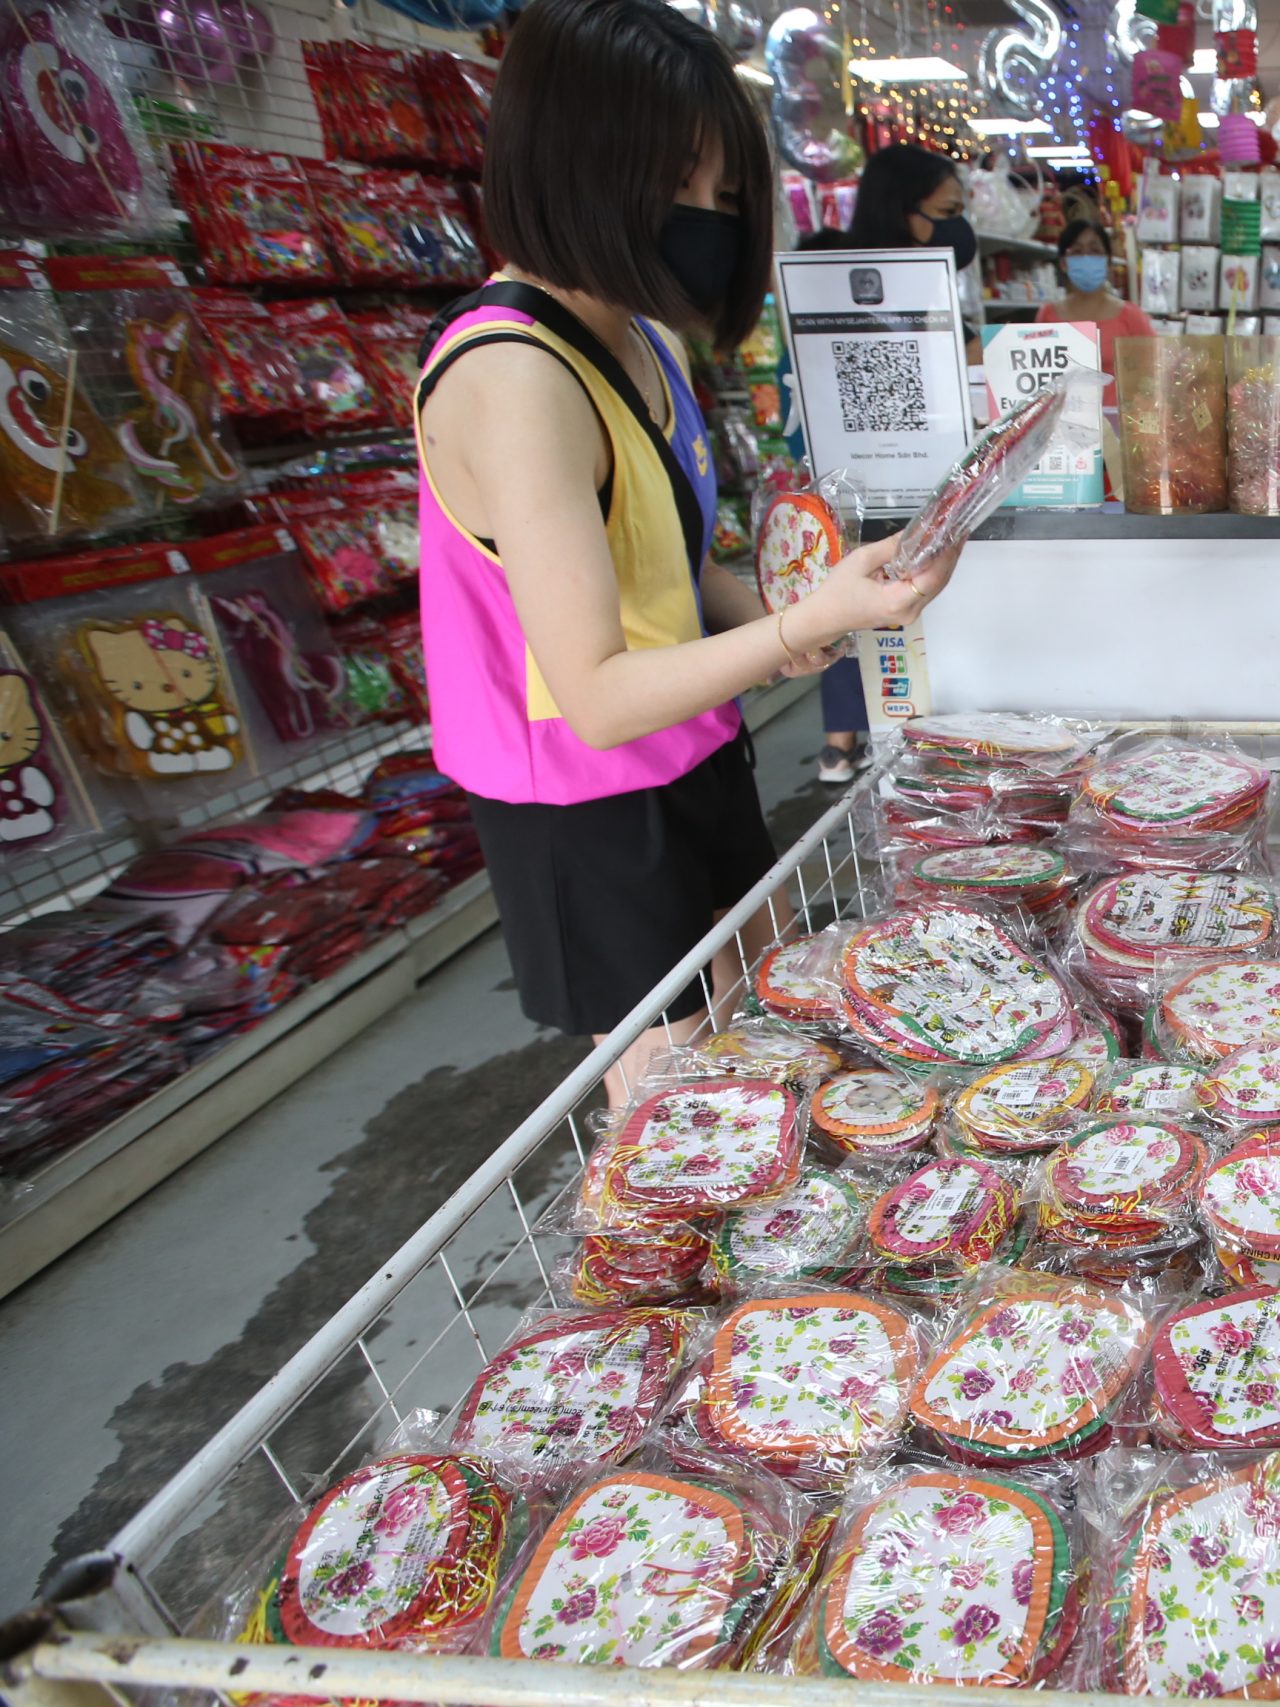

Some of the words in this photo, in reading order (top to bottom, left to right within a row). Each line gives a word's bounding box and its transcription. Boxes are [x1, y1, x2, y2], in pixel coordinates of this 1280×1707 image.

[1010, 346, 1069, 371] RM5
[874, 451, 895, 460] Home
[897, 451, 911, 460] Sdn
[876, 637, 905, 648] VISA
[1240, 1246, 1271, 1260] CHINA
[1193, 1348, 1212, 1372] 36#
